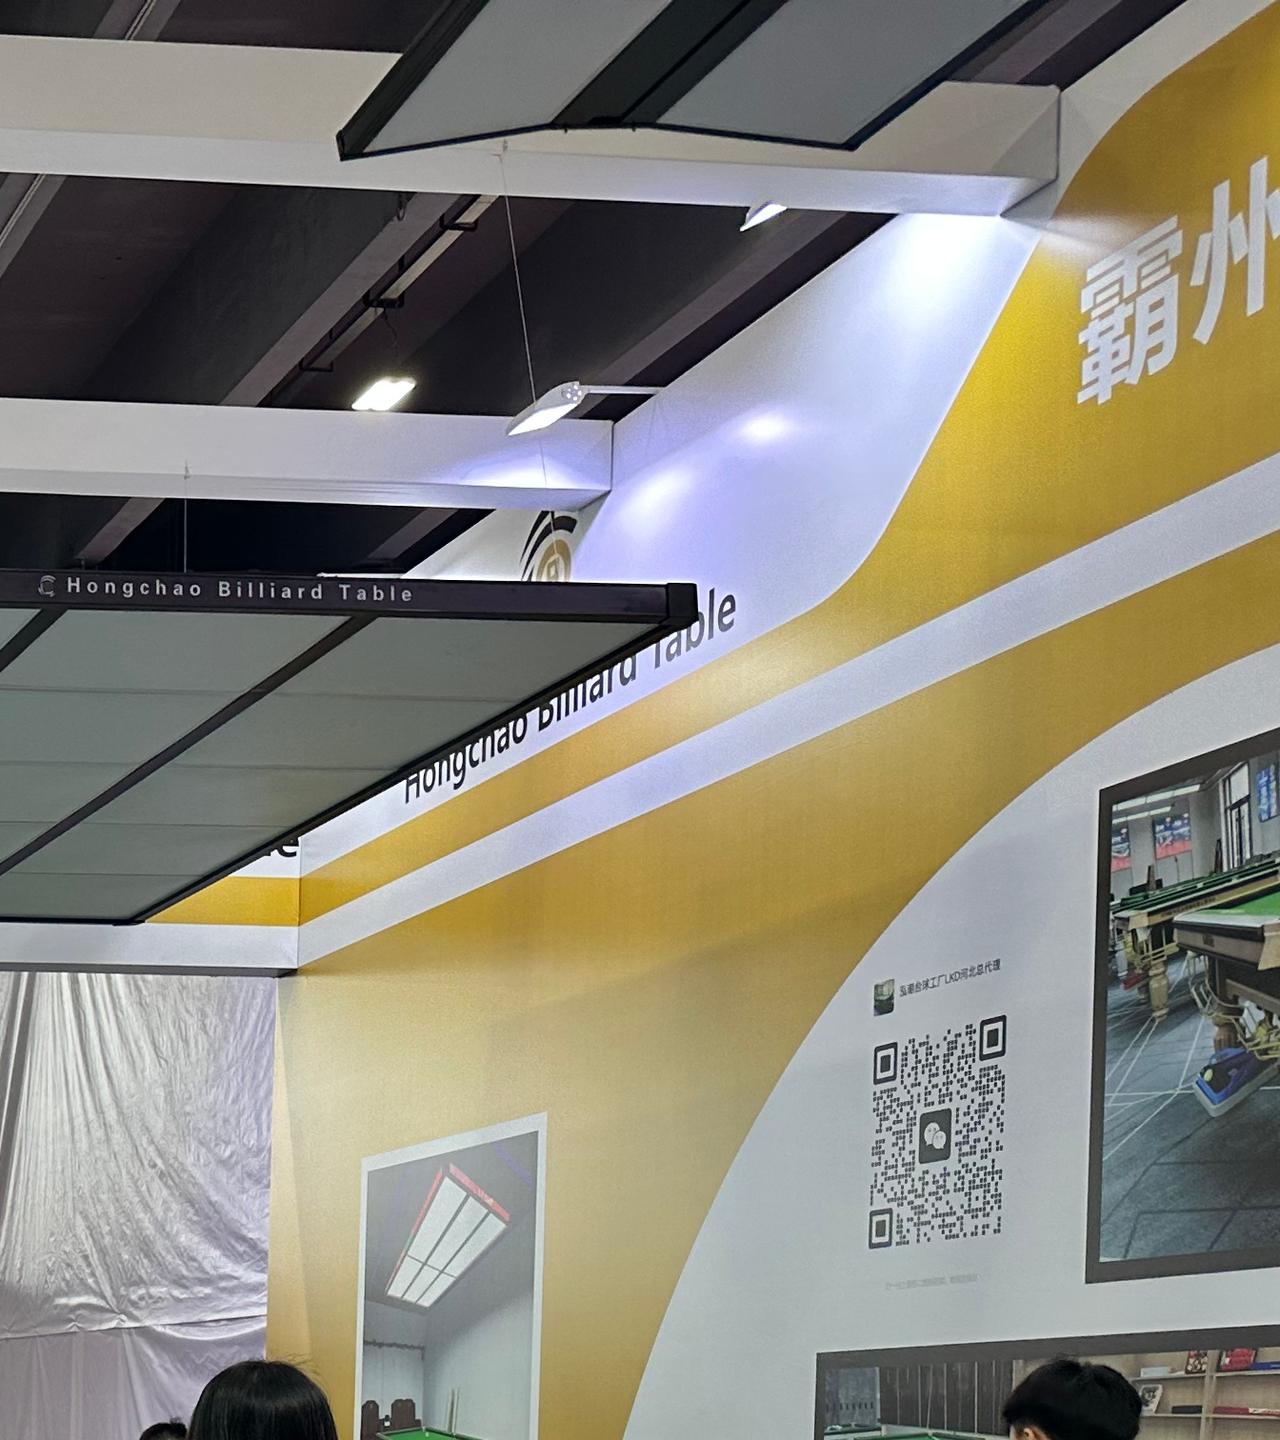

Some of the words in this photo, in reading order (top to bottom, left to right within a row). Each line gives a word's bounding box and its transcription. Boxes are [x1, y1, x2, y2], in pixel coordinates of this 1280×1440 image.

[66, 576, 203, 599] Hongchao
[218, 580, 324, 601] Billiard
[339, 584, 414, 603] Table
